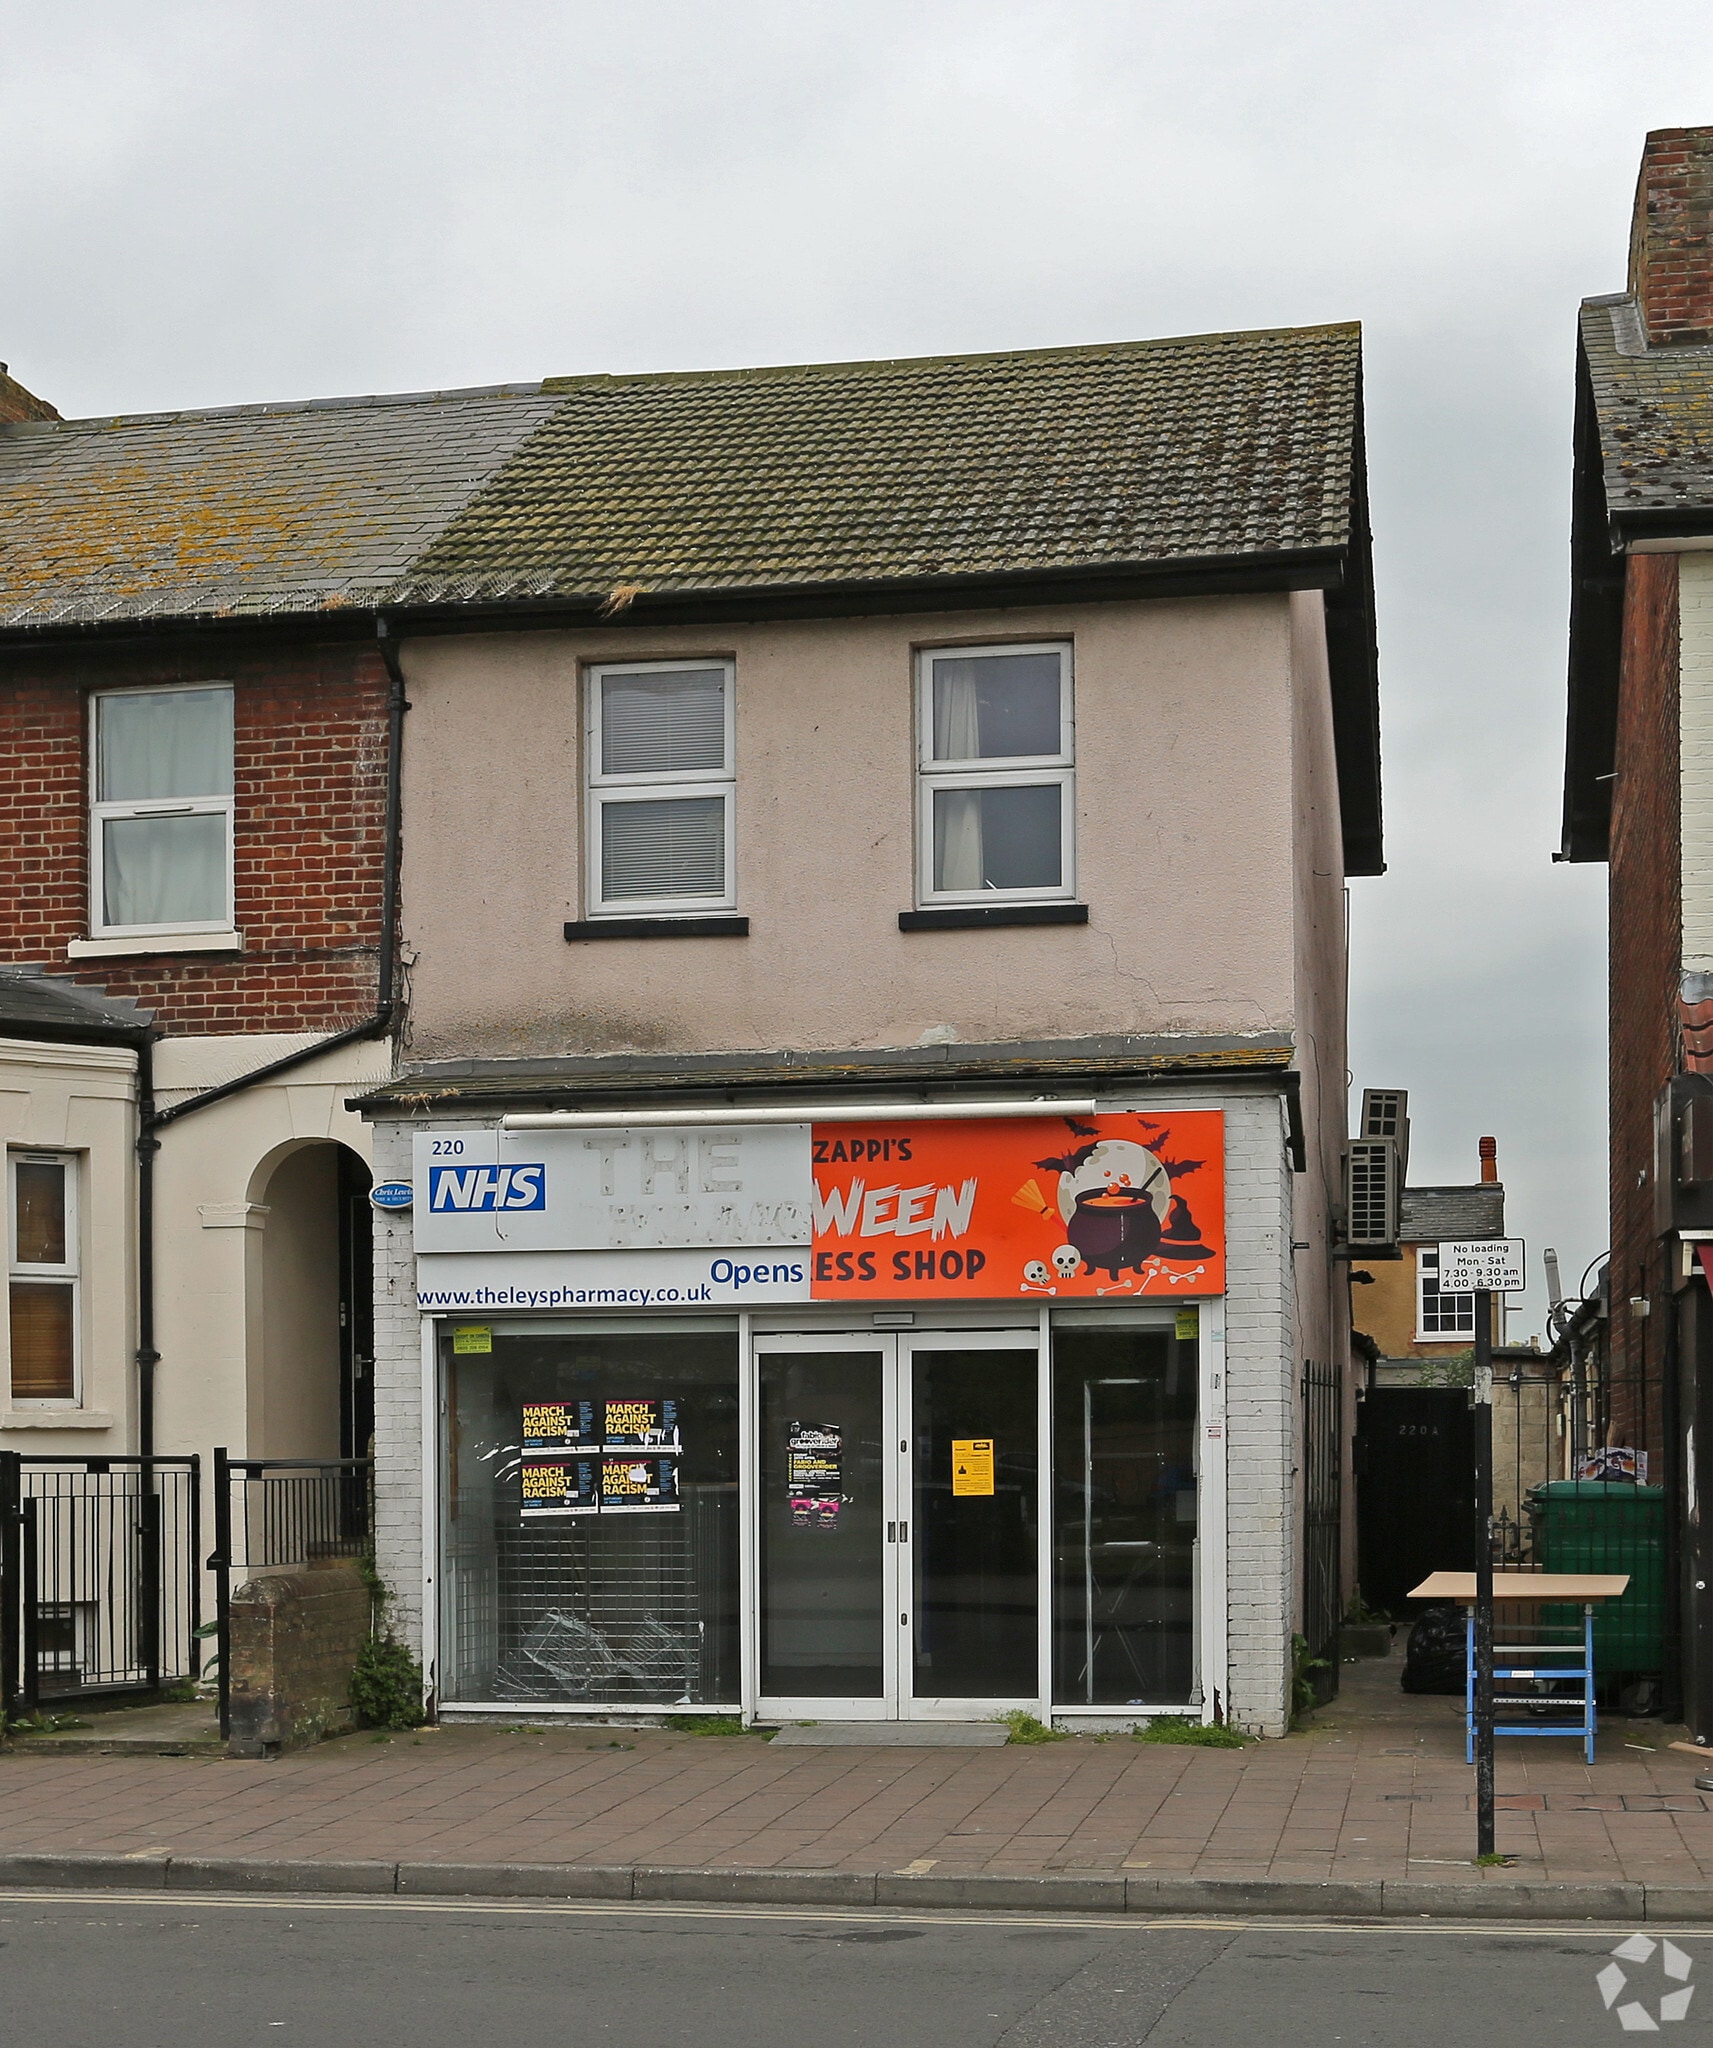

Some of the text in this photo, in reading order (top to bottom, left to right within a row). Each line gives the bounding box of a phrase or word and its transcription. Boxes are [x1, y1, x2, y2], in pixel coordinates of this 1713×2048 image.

[432, 1140, 465, 1156] 220
[813, 1138, 913, 1163] ZAPPI'S
[583, 1134, 743, 1196] THE
[433, 1167, 542, 1208] NHS
[1453, 1243, 1509, 1253] No loading
[811, 1249, 986, 1282] ESS SHOP
[1457, 1257, 1479, 1265] Mon
[1487, 1256, 1506, 1265] Sat
[710, 1258, 804, 1288] Opens
[1444, 1268, 1468, 1278] 7.30
[1476, 1268, 1501, 1277] 9.30
[1443, 1279, 1469, 1288] 4.00
[1504, 1279, 1520, 1287] pm
[417, 1283, 712, 1307] www.theleyspharmacy.co.uk
[523, 1406, 565, 1418] MARCH
[605, 1404, 649, 1414] MARCH
[522, 1415, 573, 1428] AGAINST
[605, 1413, 656, 1425] AGAINST
[523, 1426, 567, 1437] RACISM
[605, 1423, 651, 1434] RACISM
[522, 1466, 564, 1478] MARCH
[522, 1476, 572, 1488] AGAINST
[522, 1486, 567, 1498] RACISM
[603, 1484, 648, 1495] RACISM
